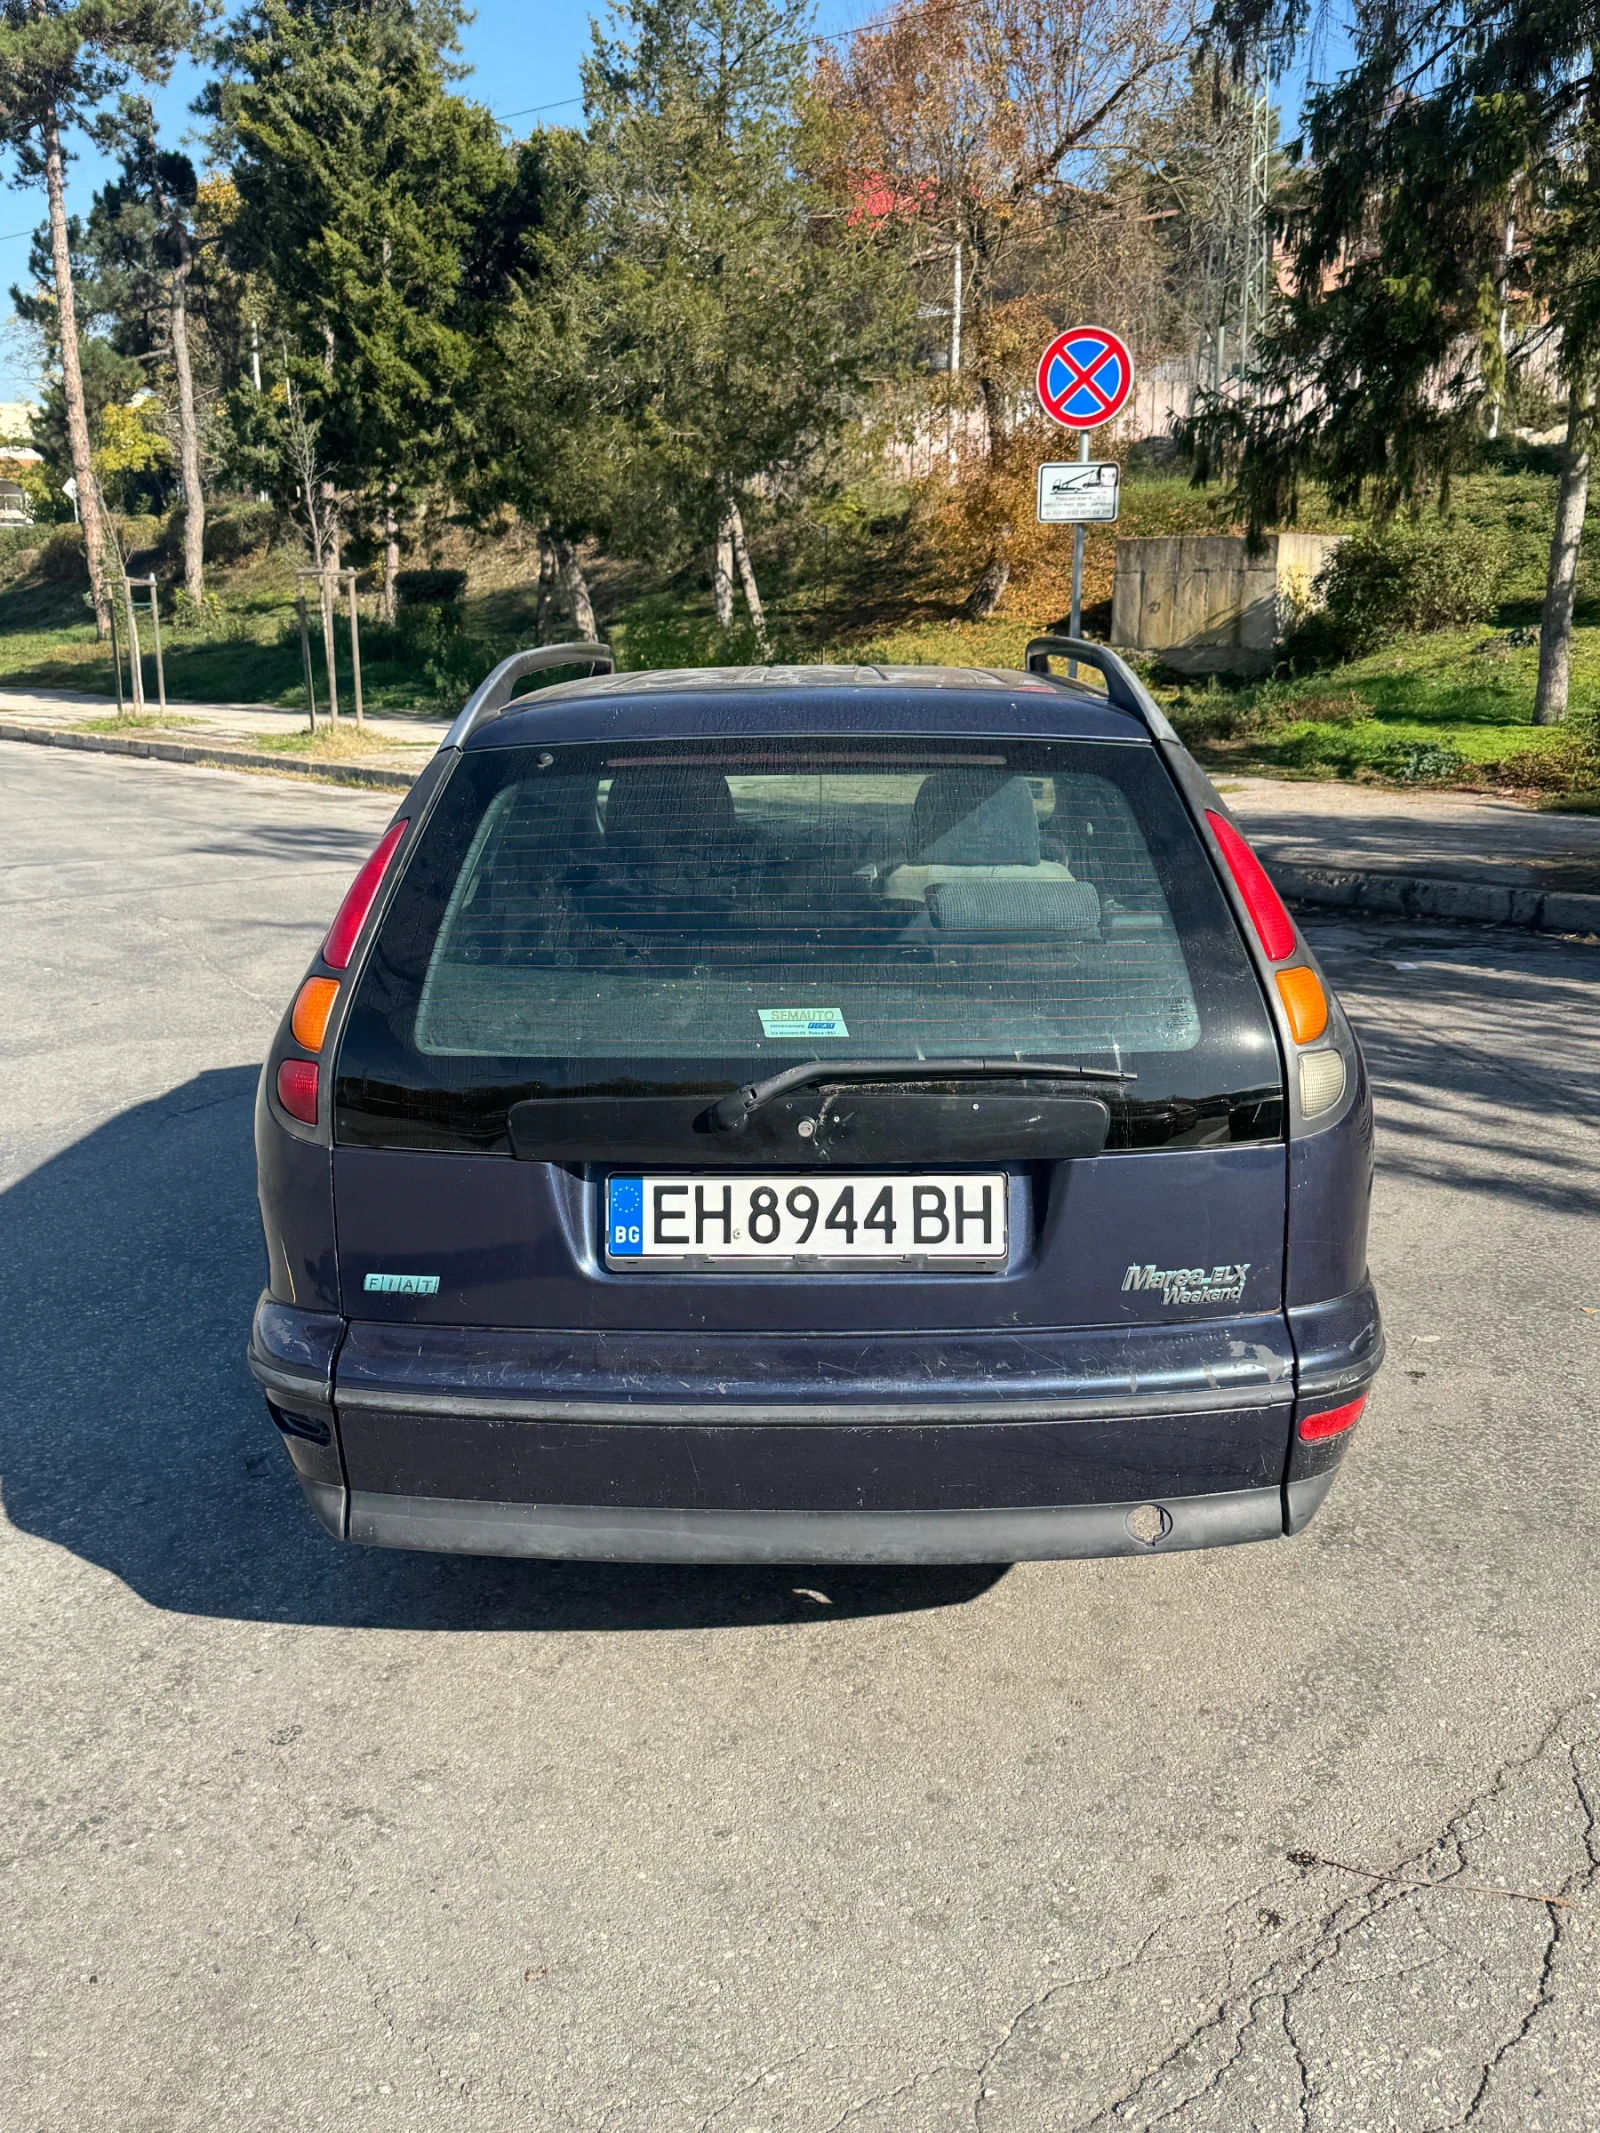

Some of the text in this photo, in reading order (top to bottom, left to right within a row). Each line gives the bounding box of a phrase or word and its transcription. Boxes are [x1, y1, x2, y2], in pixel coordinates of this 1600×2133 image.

[771, 1010, 834, 1020] SEMAUTO
[652, 1185, 992, 1244] EH 8944 BH
[614, 1225, 641, 1244] BG
[366, 1275, 438, 1293] FIAT
[1120, 1263, 1251, 1291] Marea ELX
[1161, 1282, 1245, 1306] Weekend
